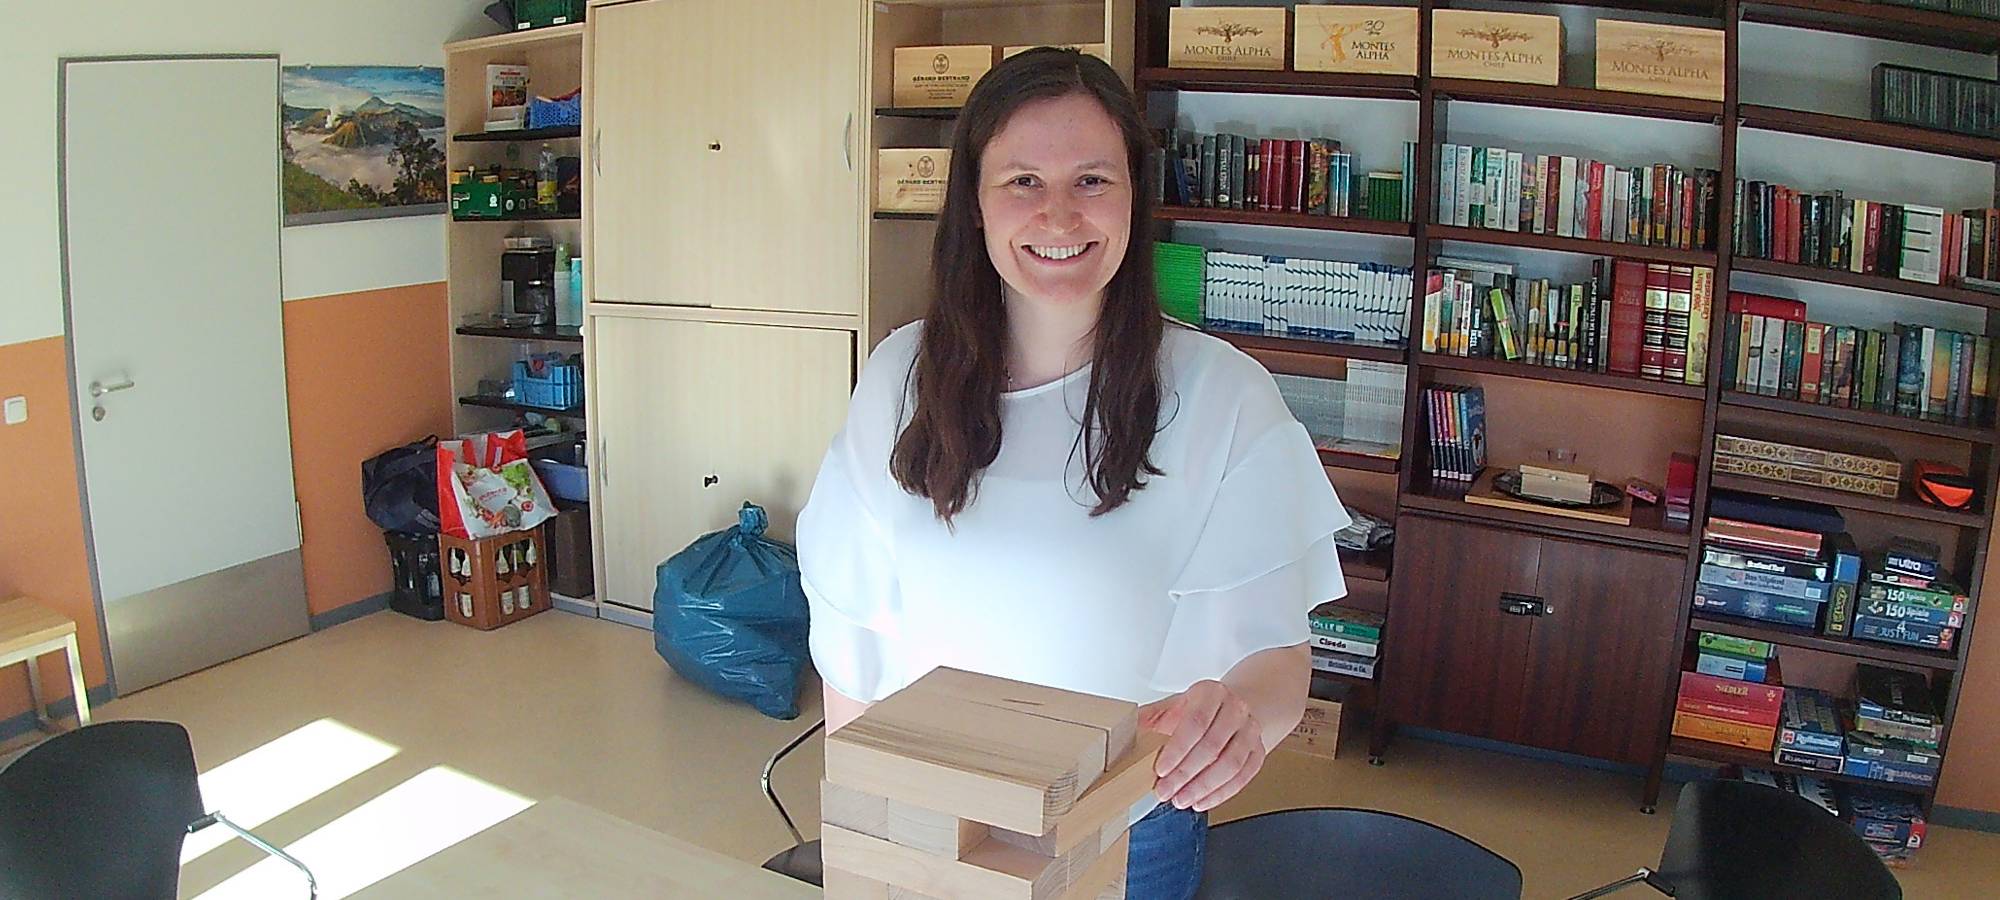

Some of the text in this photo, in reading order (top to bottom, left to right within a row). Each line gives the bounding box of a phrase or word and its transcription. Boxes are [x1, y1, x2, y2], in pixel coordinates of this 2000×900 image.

[1364, 19, 1385, 31] 30
[1184, 44, 1271, 56] MONTES ALPHA
[1352, 41, 1395, 51] MONTES
[1356, 50, 1389, 60] ALPHA
[1448, 49, 1543, 64] MONTES ALPHA
[1611, 60, 1709, 80] MONTES ALPHA
[1887, 589, 1904, 602] 150
[1886, 603, 1905, 618] 150
[1880, 627, 1900, 639] JUST
[1897, 620, 1906, 634] 4
[1903, 631, 1920, 641] FUN
